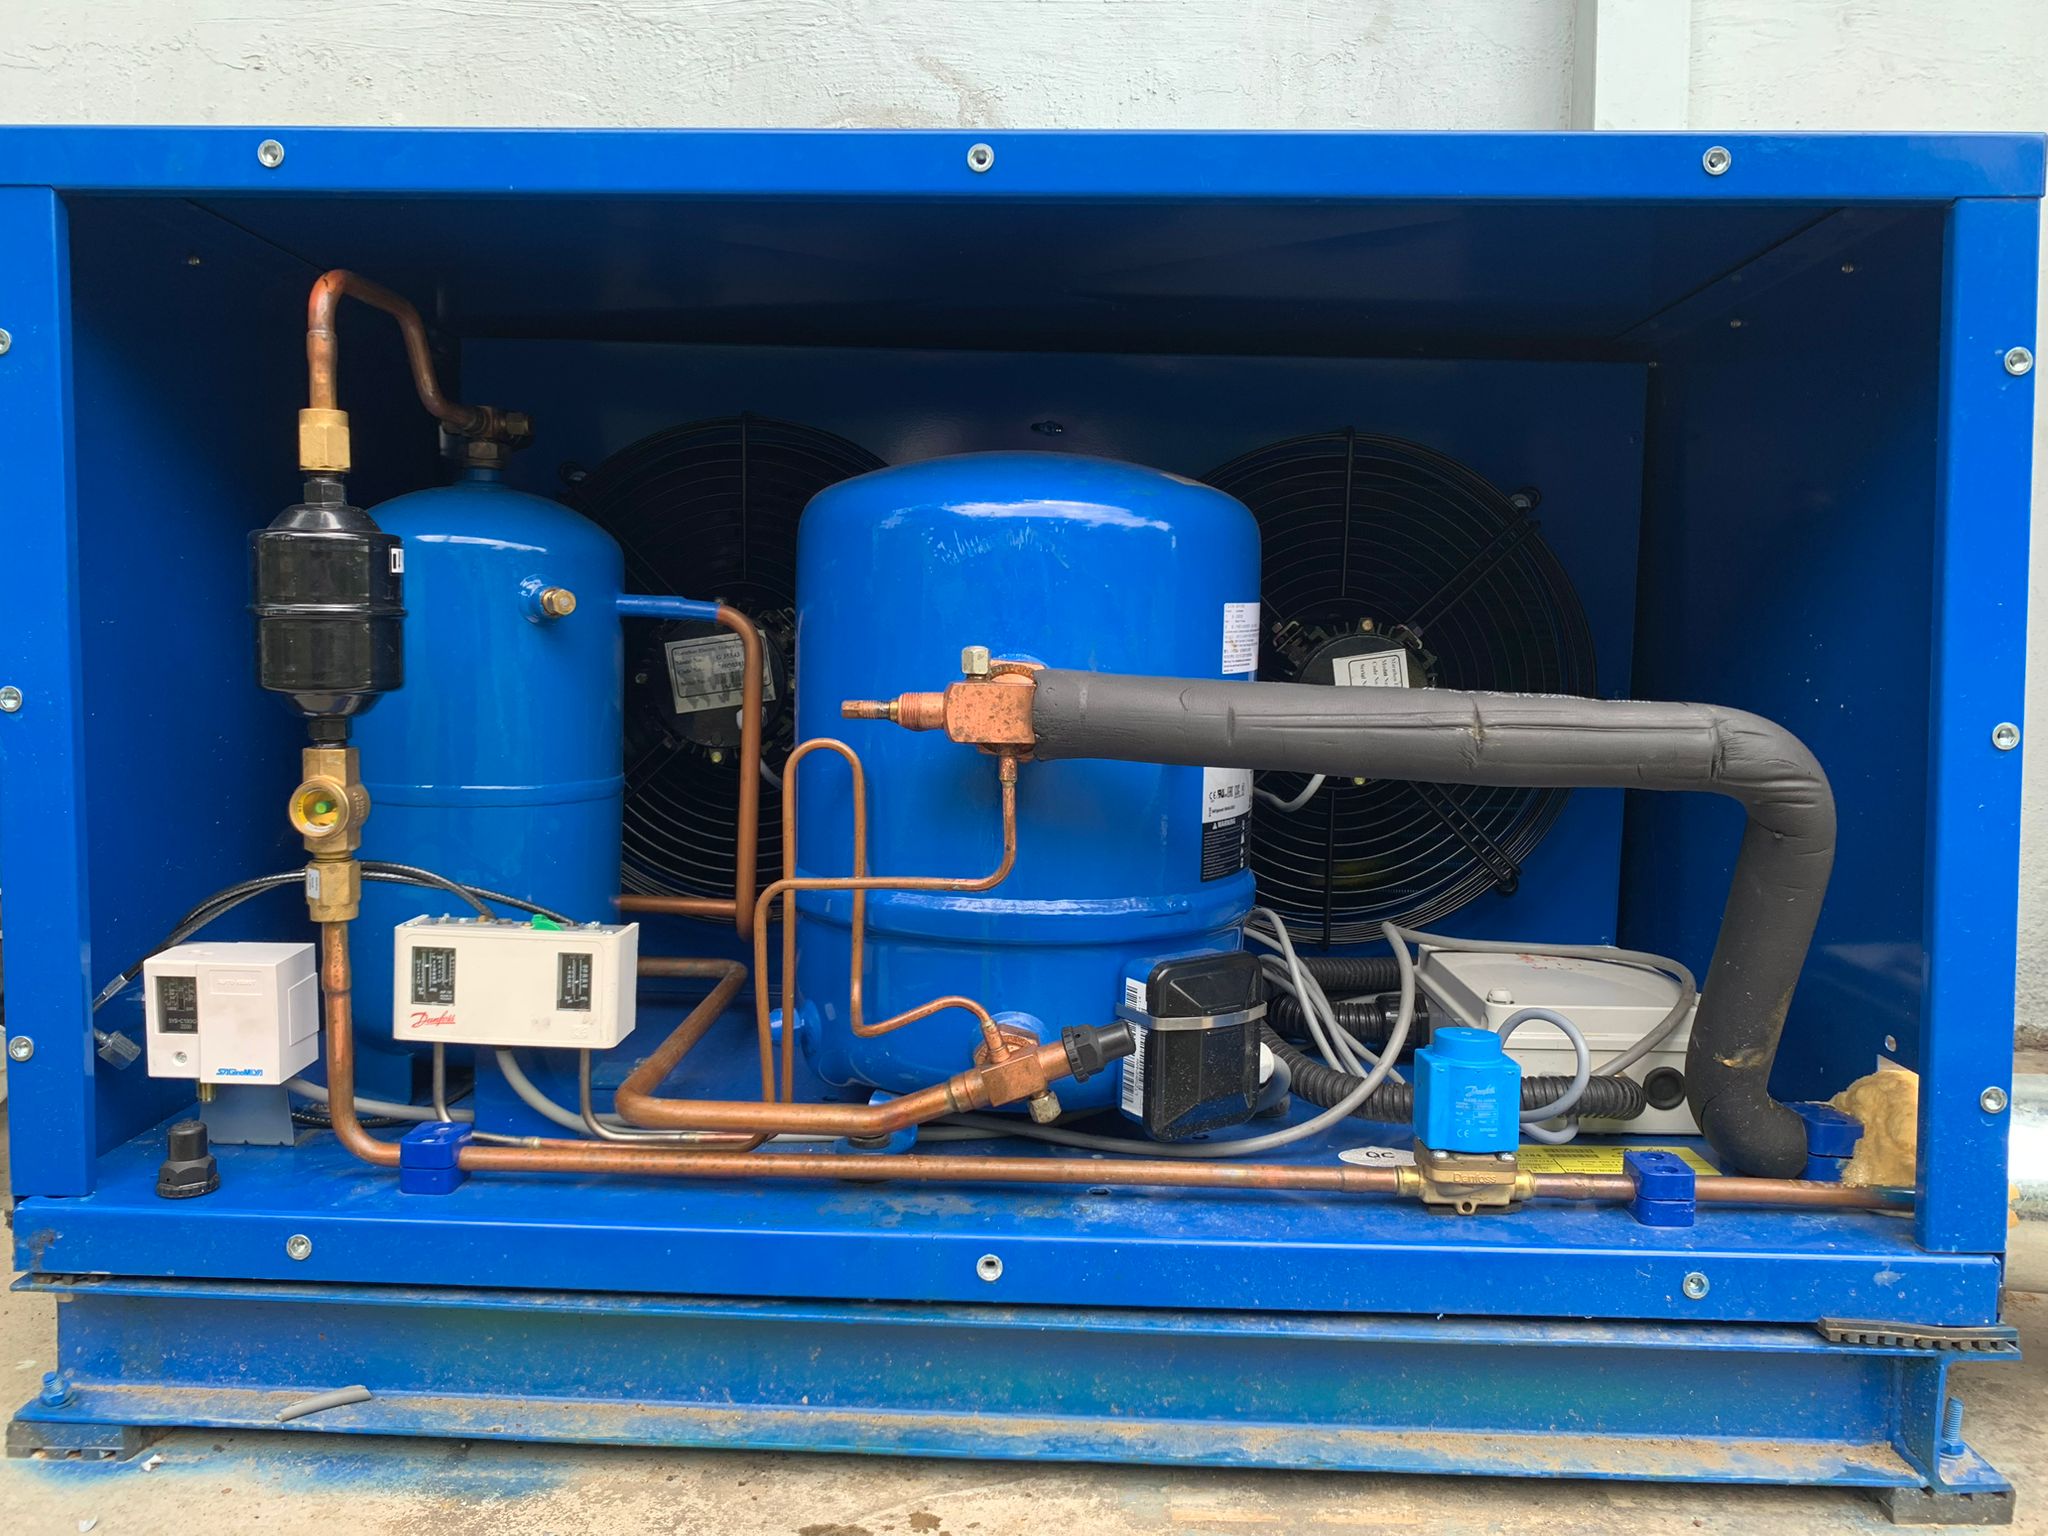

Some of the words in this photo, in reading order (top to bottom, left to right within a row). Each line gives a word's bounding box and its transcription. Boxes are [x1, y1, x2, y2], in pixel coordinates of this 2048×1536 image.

[410, 1010, 456, 1028] Danfoss
[1365, 1151, 1395, 1159] QC
[1453, 1172, 1497, 1184] Danfoss
